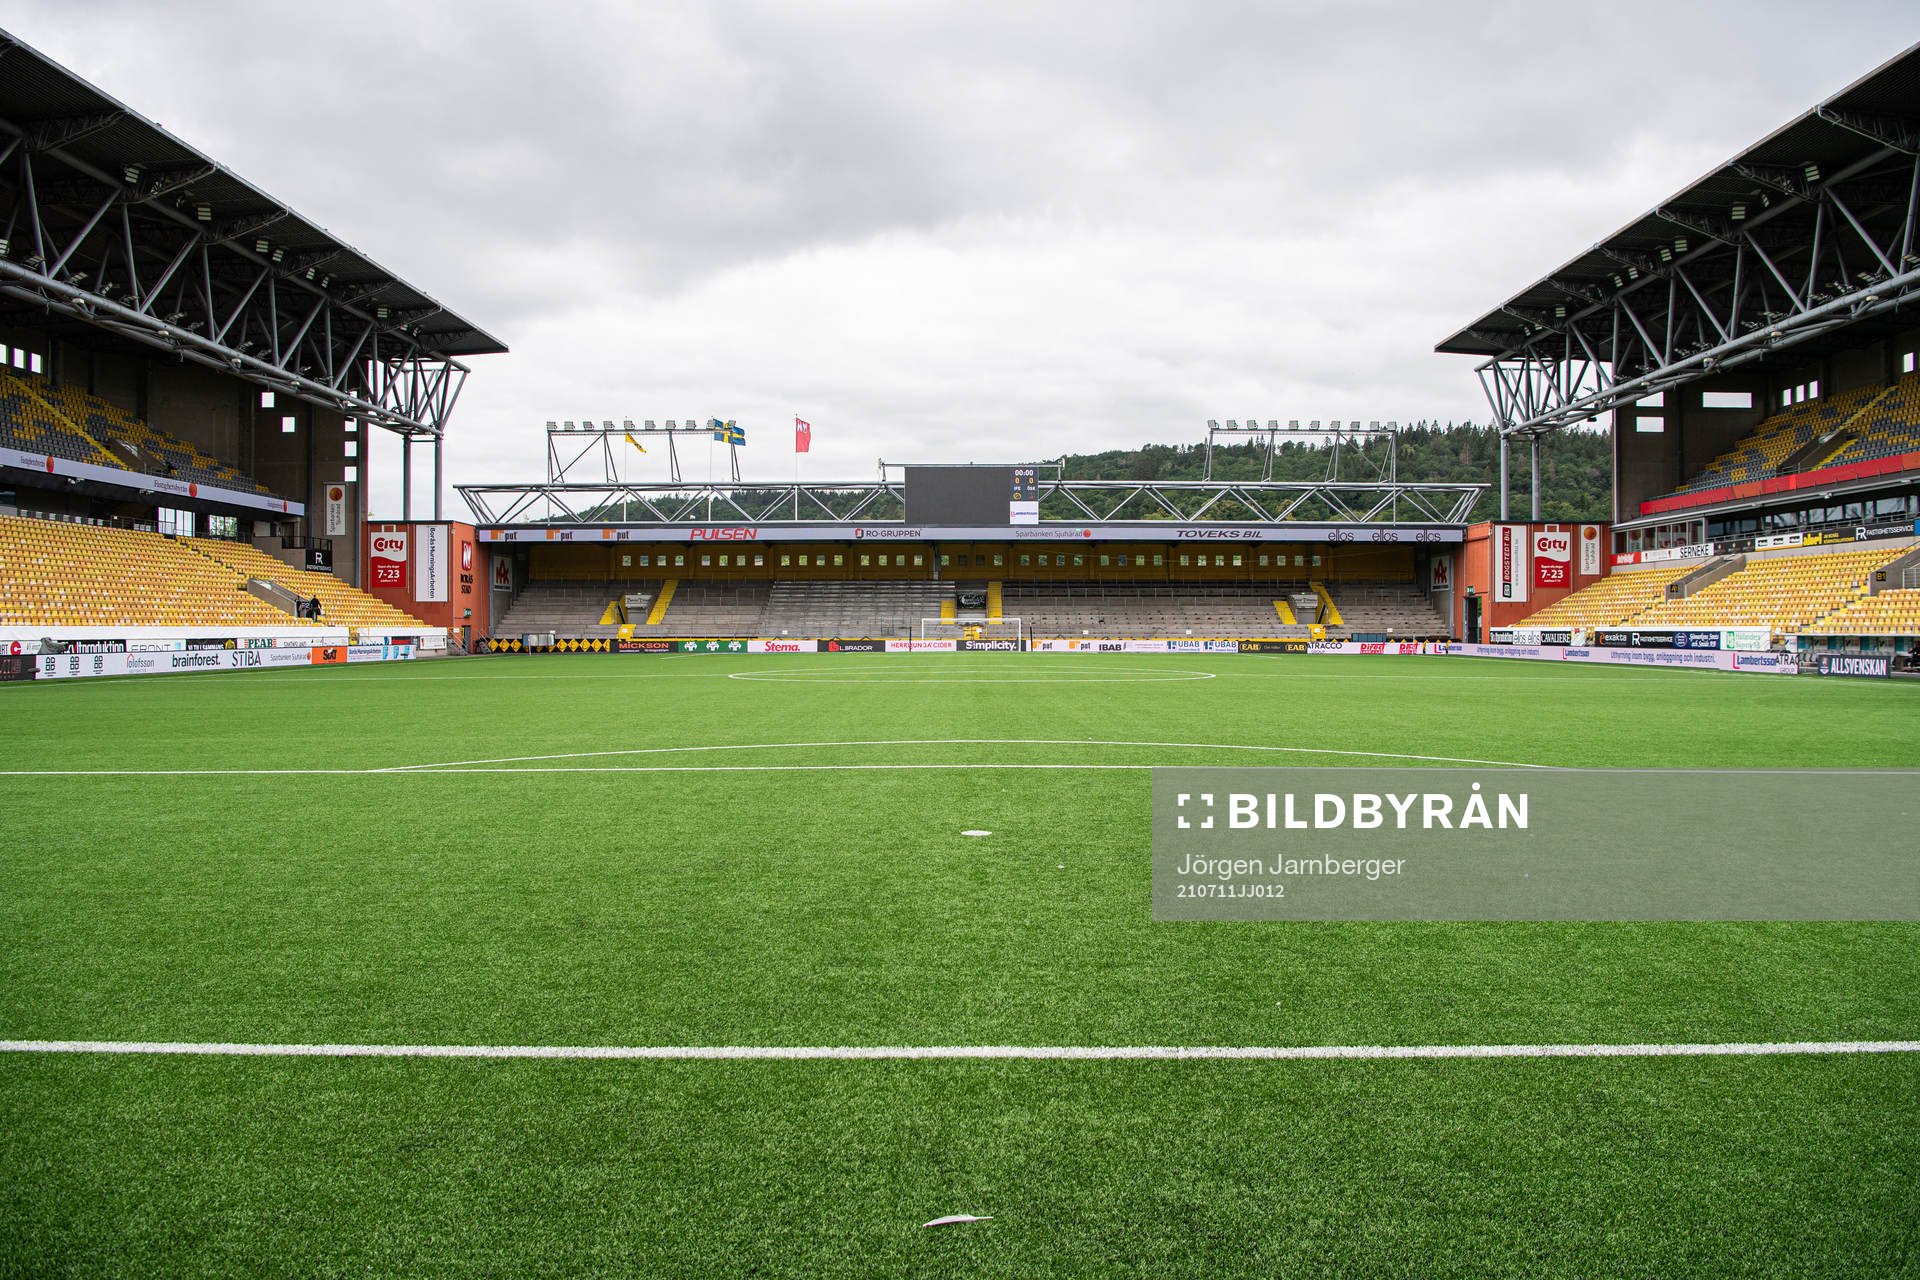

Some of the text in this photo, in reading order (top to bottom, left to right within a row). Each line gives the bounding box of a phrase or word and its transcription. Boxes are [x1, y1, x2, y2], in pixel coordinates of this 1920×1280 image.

[690, 528, 758, 541] PULSEN
[1016, 530, 1082, 538] Sparbanken Sjuhärad
[1328, 529, 1354, 541] ellos
[1372, 529, 1398, 541] ellos
[374, 537, 404, 552] City
[1537, 537, 1567, 552] City
[1680, 544, 1710, 558] SERNEKE
[377, 570, 400, 579] 7-23
[1541, 570, 1564, 578] 7-23
[248, 638, 273, 648] PEAB
[232, 650, 262, 667] STIBA
[1831, 658, 1887, 675] ALLSVENSKAN
